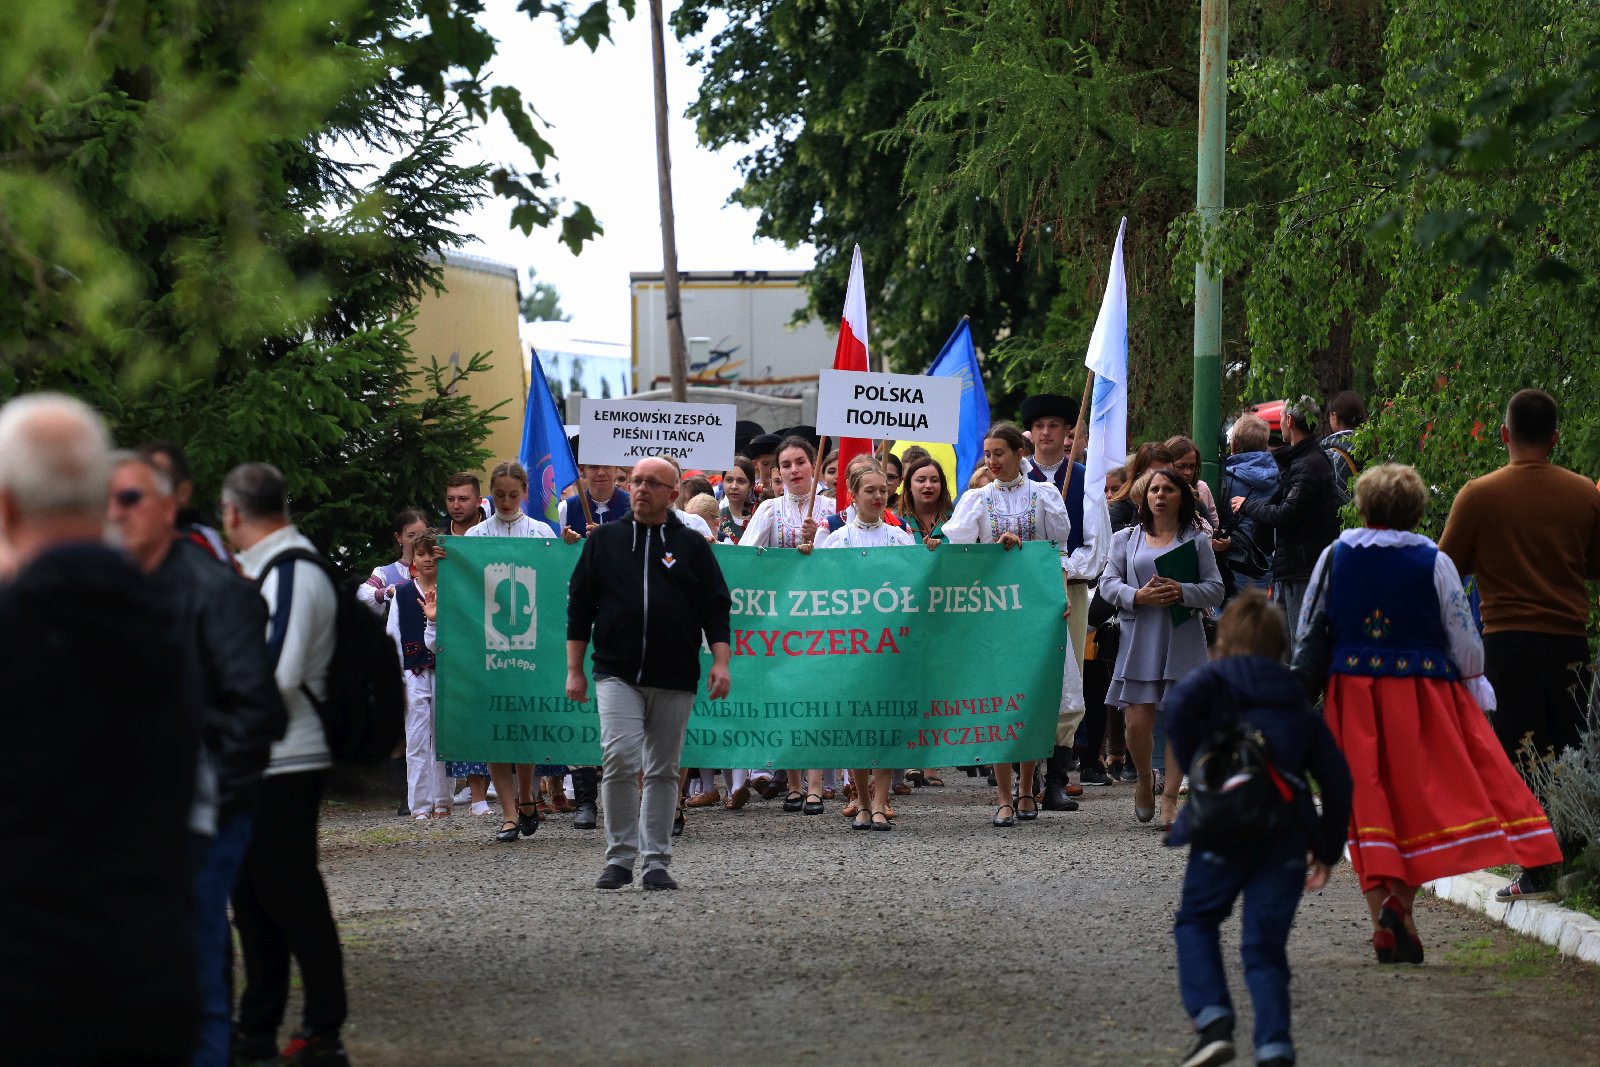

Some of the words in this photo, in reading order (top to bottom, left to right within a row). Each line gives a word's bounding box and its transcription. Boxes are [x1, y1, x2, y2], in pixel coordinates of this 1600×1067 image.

[854, 385, 924, 403] POLSKA
[594, 410, 671, 424] ŁEMKOWSKI
[673, 413, 722, 426] ZESPÓŁ
[846, 408, 929, 431] ПОЛЬЩА
[613, 427, 653, 440] PIEŚNI
[656, 430, 660, 440] I
[664, 429, 705, 443] TAŃCA
[789, 582, 919, 616] ZESPÓŁ
[928, 581, 1022, 612] PIEŚNI
[732, 627, 910, 656] KYCZERA”
[764, 700, 828, 719] ПІСНІ
[847, 700, 919, 721] ТАНЦЯ
[492, 723, 575, 743] LEMKO
[684, 728, 717, 746] ND
[722, 729, 784, 748] SONG
[790, 729, 902, 748] ENSEMBLE
[906, 721, 1025, 750] „KYCZERA”
